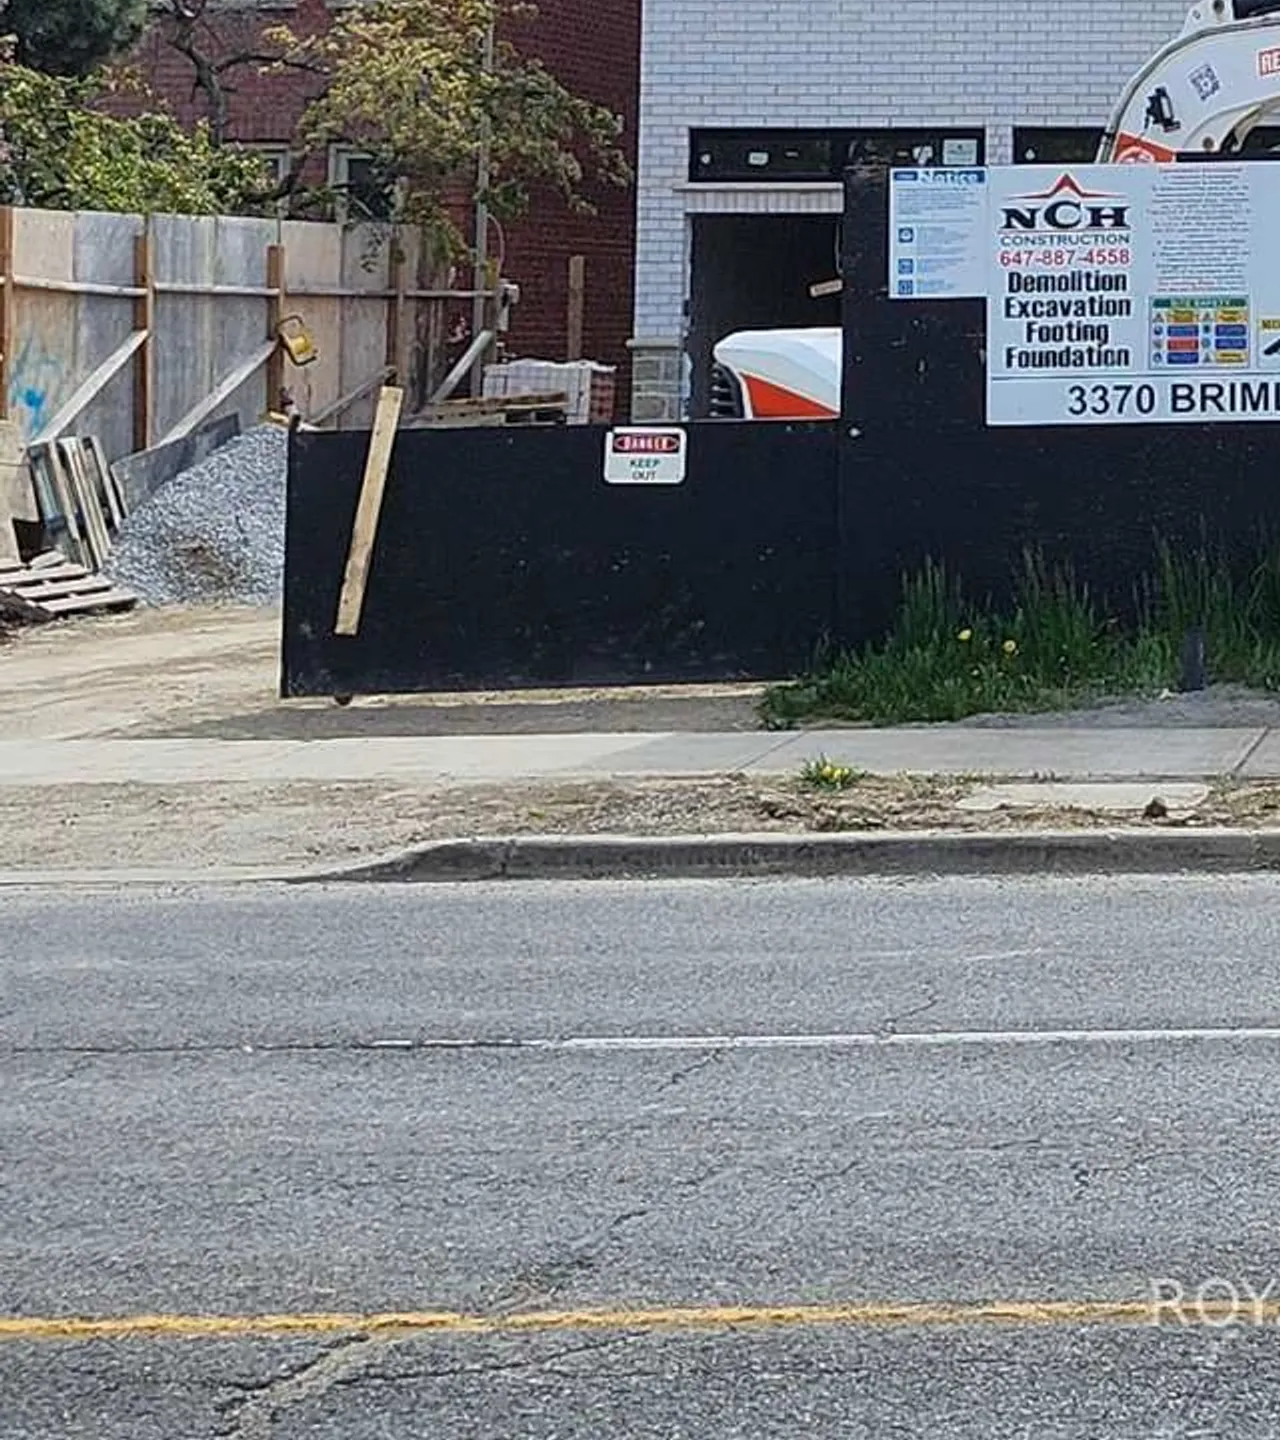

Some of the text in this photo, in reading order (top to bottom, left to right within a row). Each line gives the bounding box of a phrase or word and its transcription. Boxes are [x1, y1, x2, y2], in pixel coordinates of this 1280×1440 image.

[1001, 200, 1131, 229] NCH
[1000, 233, 1131, 247] CONSTRUCTION
[999, 248, 1130, 267] 647-887-4558
[1007, 269, 1127, 293] Demolition
[1004, 295, 1131, 318] Excavation
[1026, 320, 1109, 345] Footing
[1006, 345, 1129, 368] Foundation
[1068, 384, 1155, 415] 3370
[623, 436, 668, 450] DANGER
[630, 458, 661, 469] KEEP
[632, 471, 657, 480] OUT
